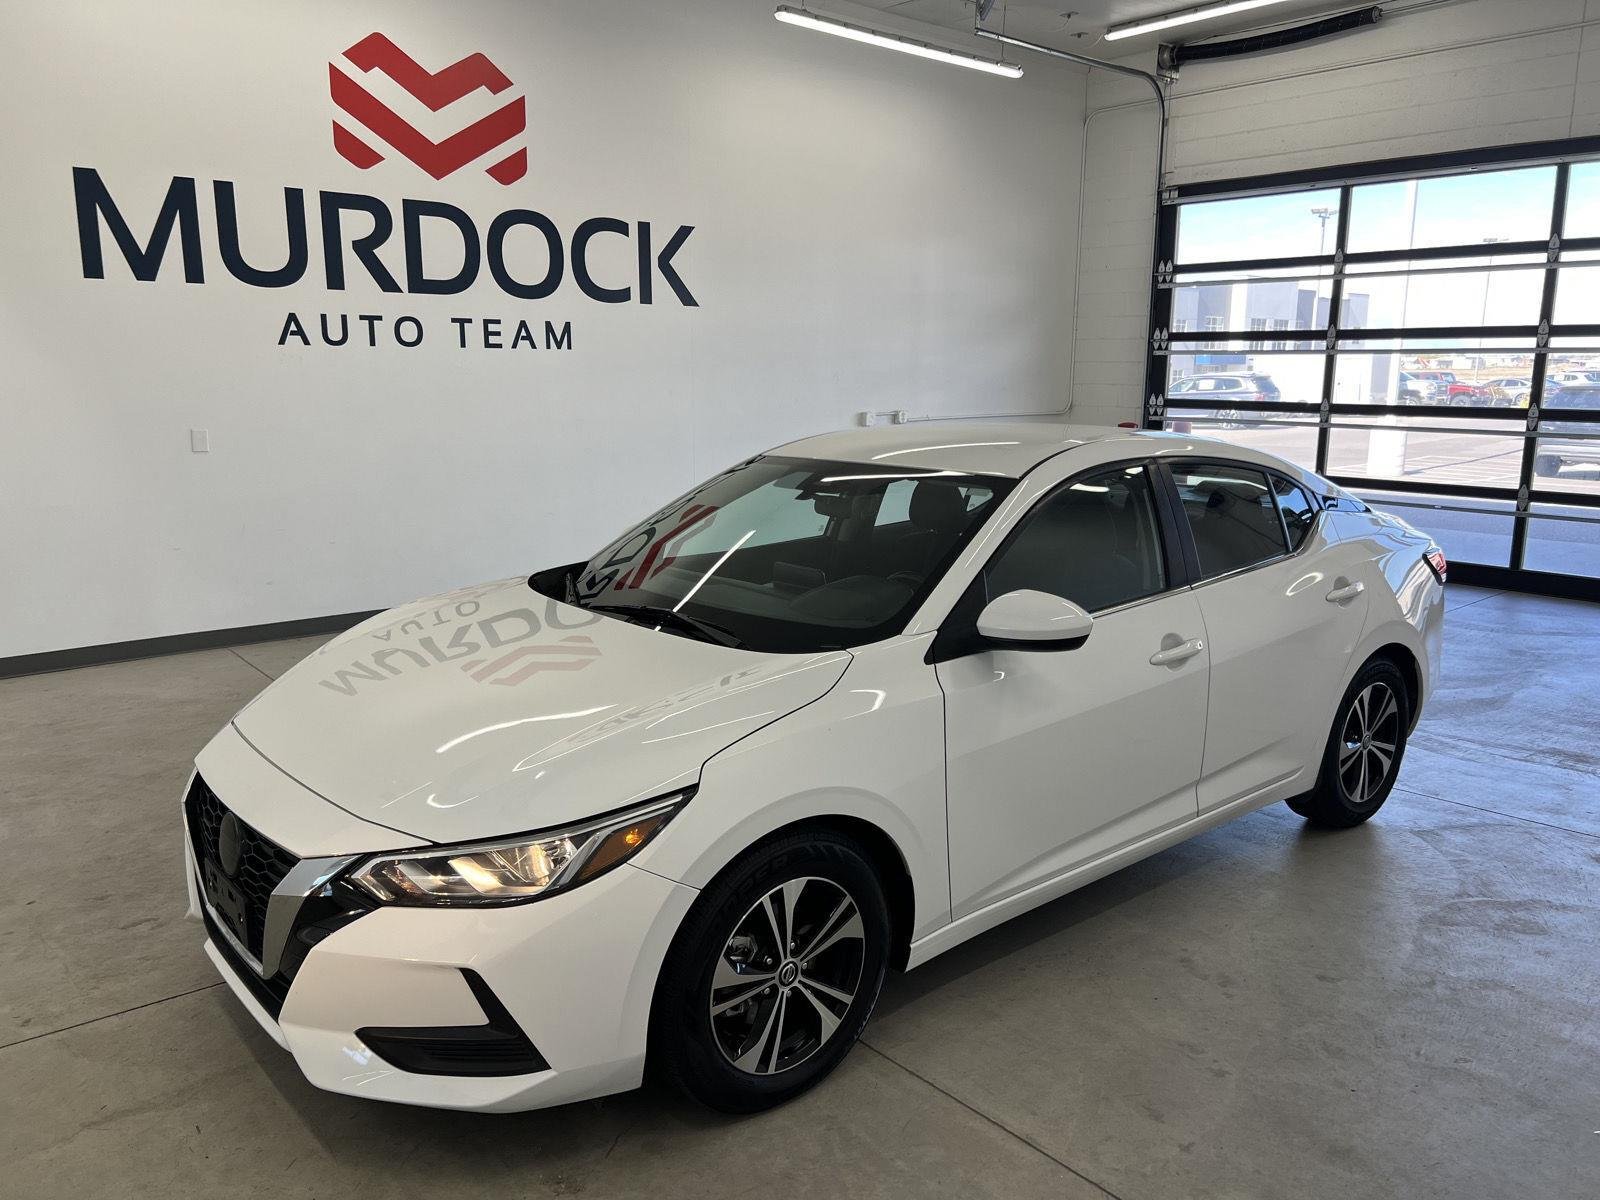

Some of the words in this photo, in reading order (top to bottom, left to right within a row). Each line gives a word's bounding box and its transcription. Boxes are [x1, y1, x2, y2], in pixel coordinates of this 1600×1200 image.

[72, 166, 700, 308] MURDOCK
[277, 312, 424, 348] AUTO
[450, 317, 573, 351] TEAM
